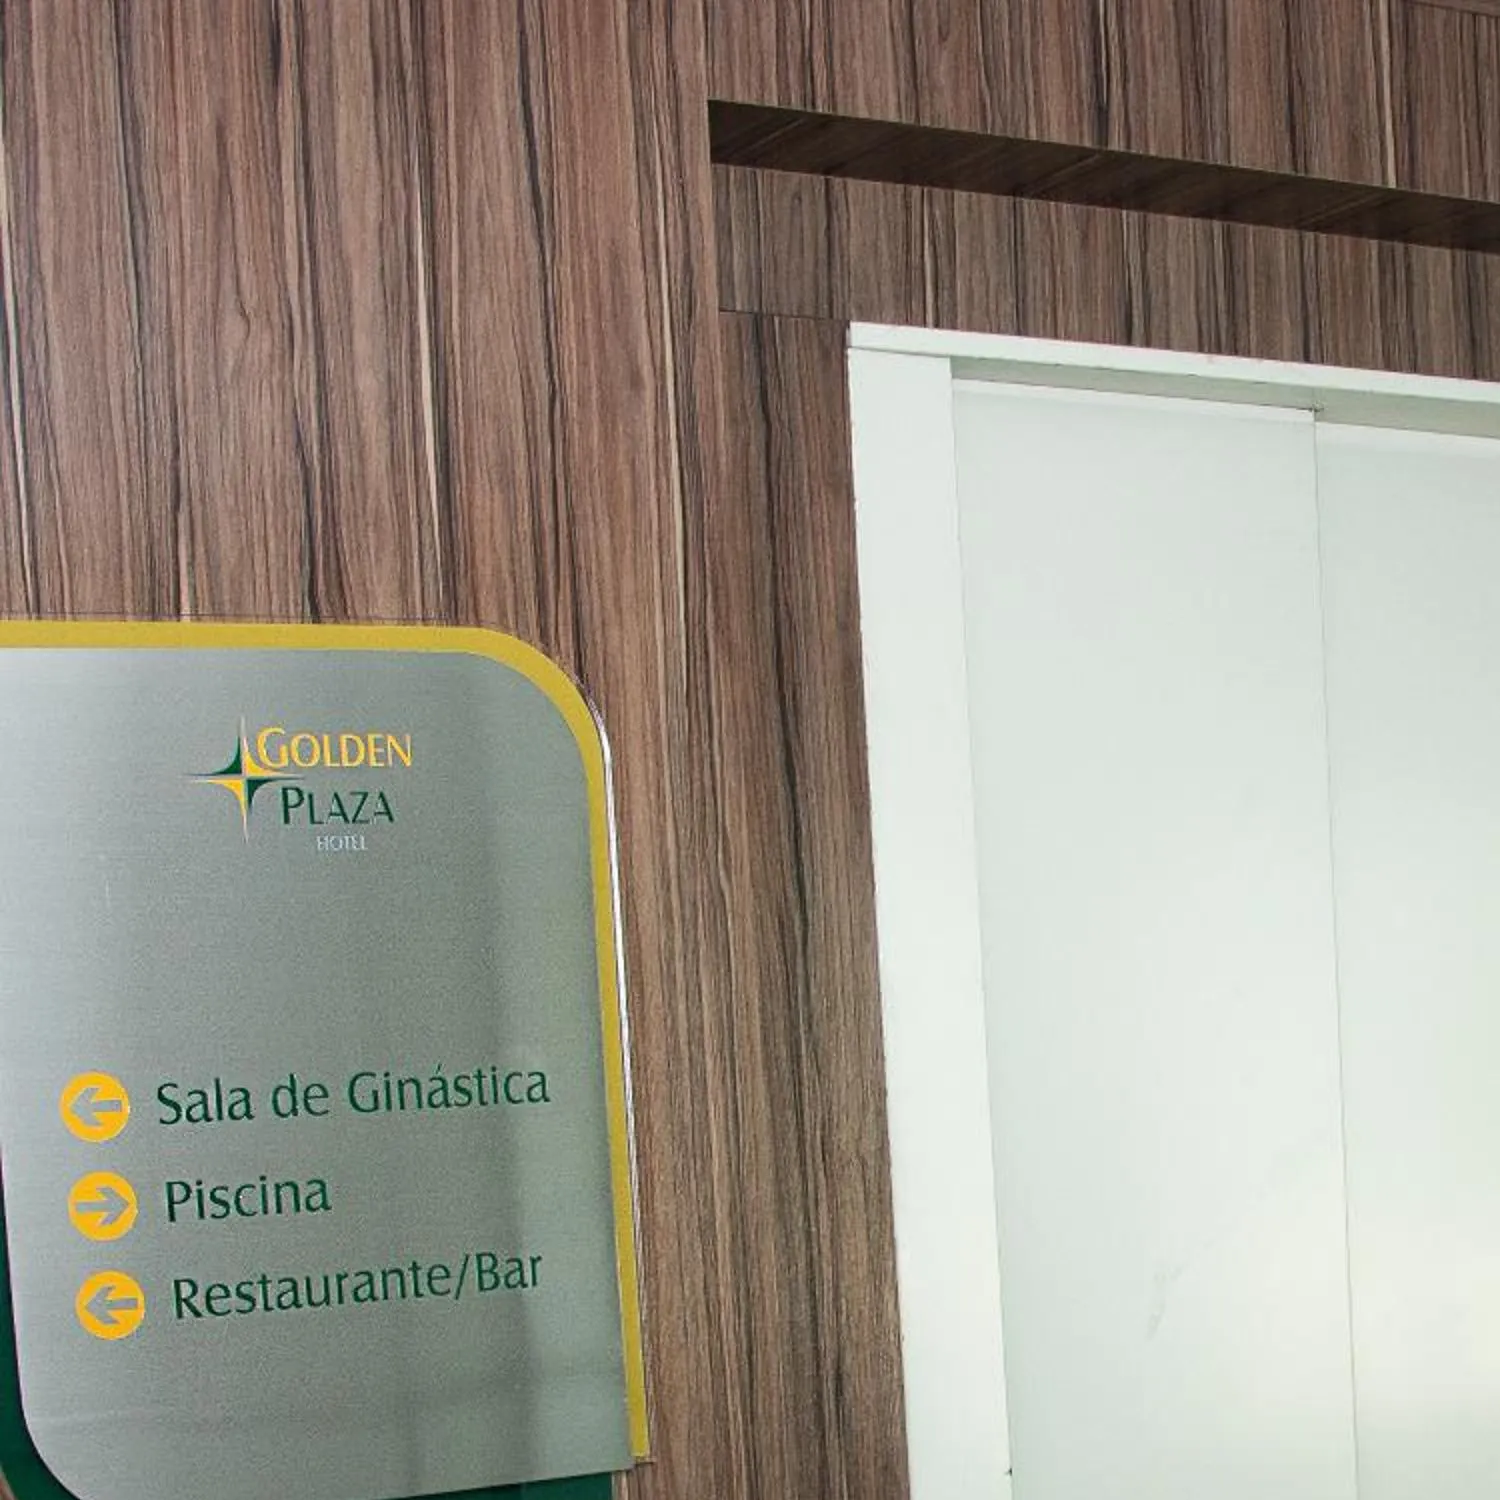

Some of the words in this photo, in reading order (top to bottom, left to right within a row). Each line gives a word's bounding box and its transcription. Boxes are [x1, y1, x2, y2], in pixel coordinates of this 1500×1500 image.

[257, 728, 412, 768] GOLDEN
[280, 785, 394, 825] PLAZA
[316, 834, 368, 851] HOTEL
[156, 1078, 255, 1125] Sala
[271, 1075, 330, 1117] de
[347, 1063, 551, 1114] Ginástica
[165, 1175, 332, 1222] Piscina
[172, 1252, 544, 1320] Restaurante/Bar
